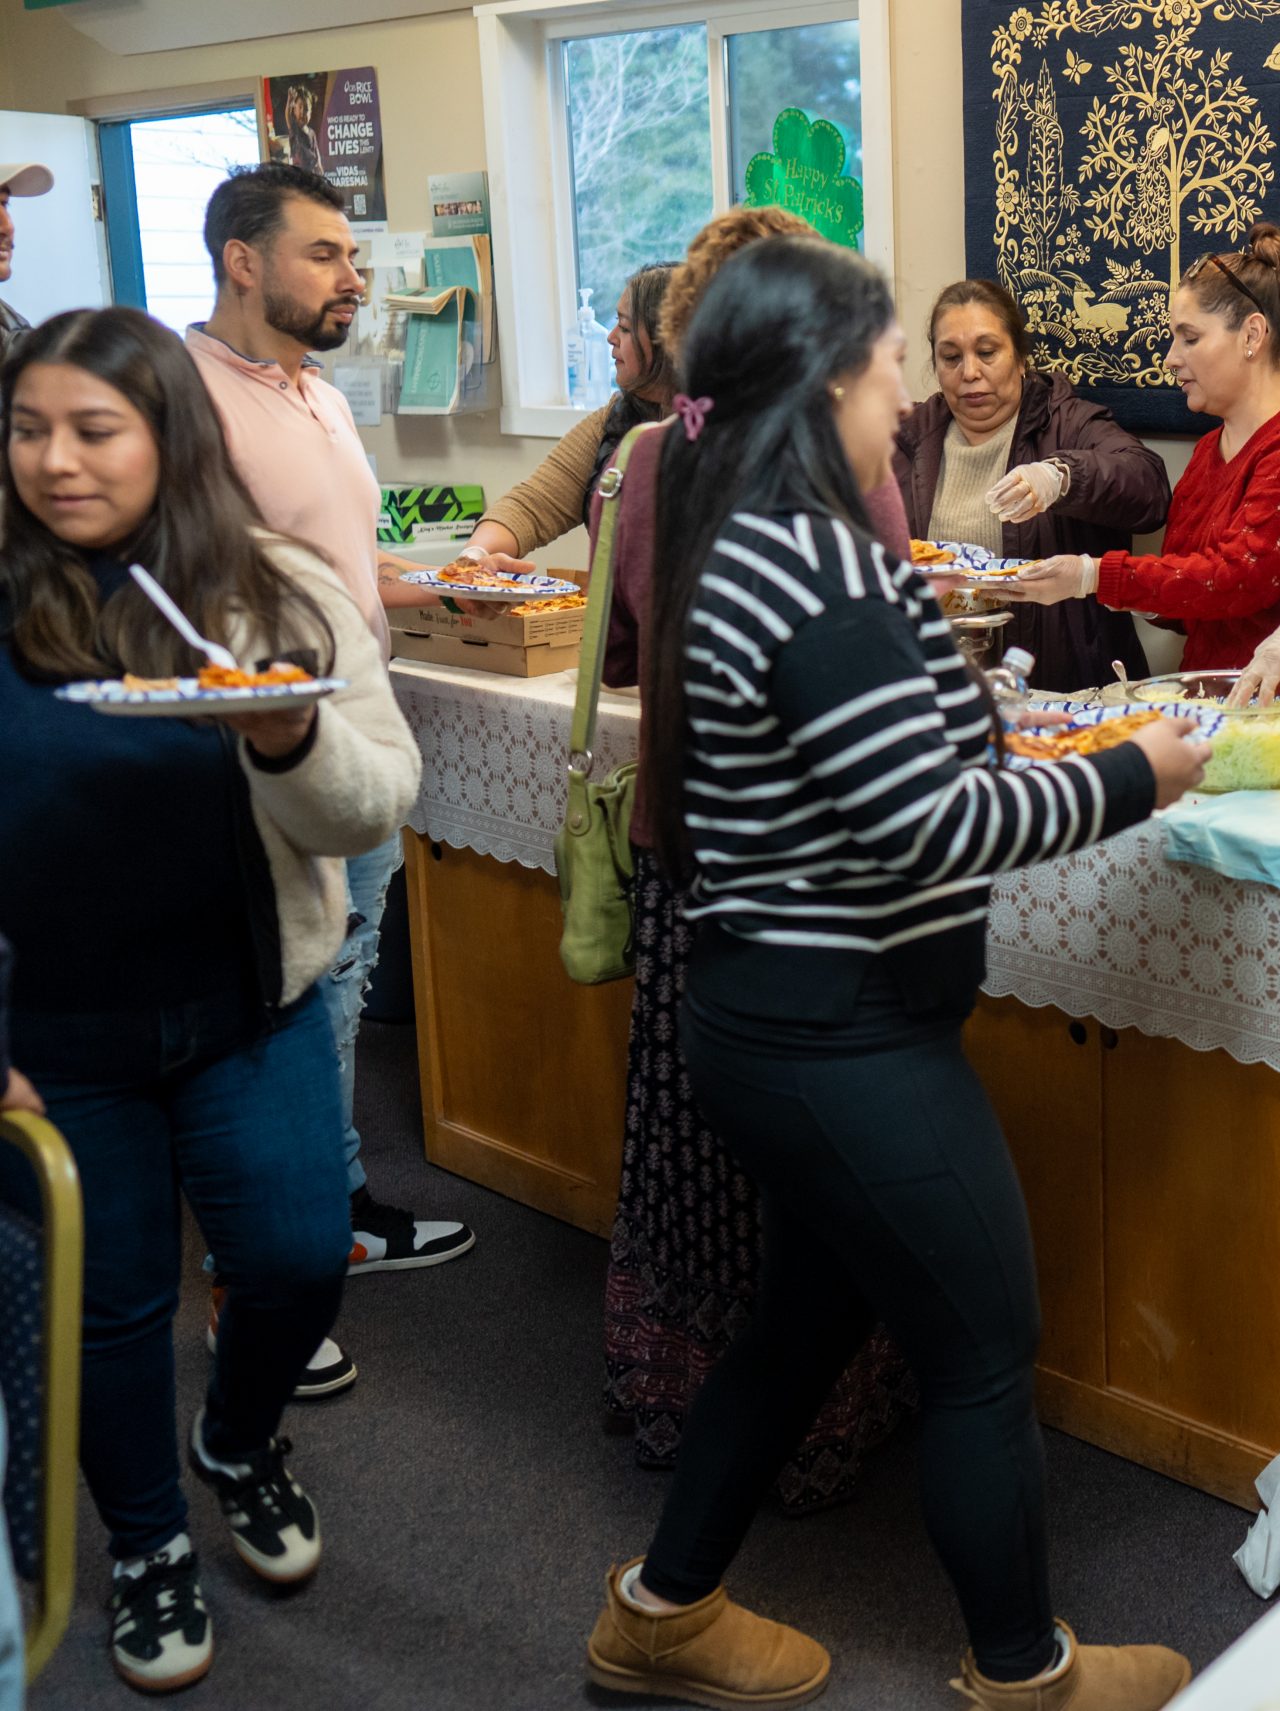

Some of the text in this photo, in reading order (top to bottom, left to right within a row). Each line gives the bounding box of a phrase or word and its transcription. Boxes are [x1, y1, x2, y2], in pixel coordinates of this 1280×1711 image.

[356, 82, 373, 93] RICE
[349, 93, 373, 105] BOWL
[327, 116, 338, 124] WHO
[344, 114, 359, 123] READY
[359, 113, 366, 121] TO
[327, 122, 374, 140] CHANGE
[328, 139, 370, 156] LIVES THIS
[335, 165, 359, 177] VIDAS
[784, 158, 828, 192] Happy
[418, 609, 433, 622] Made
